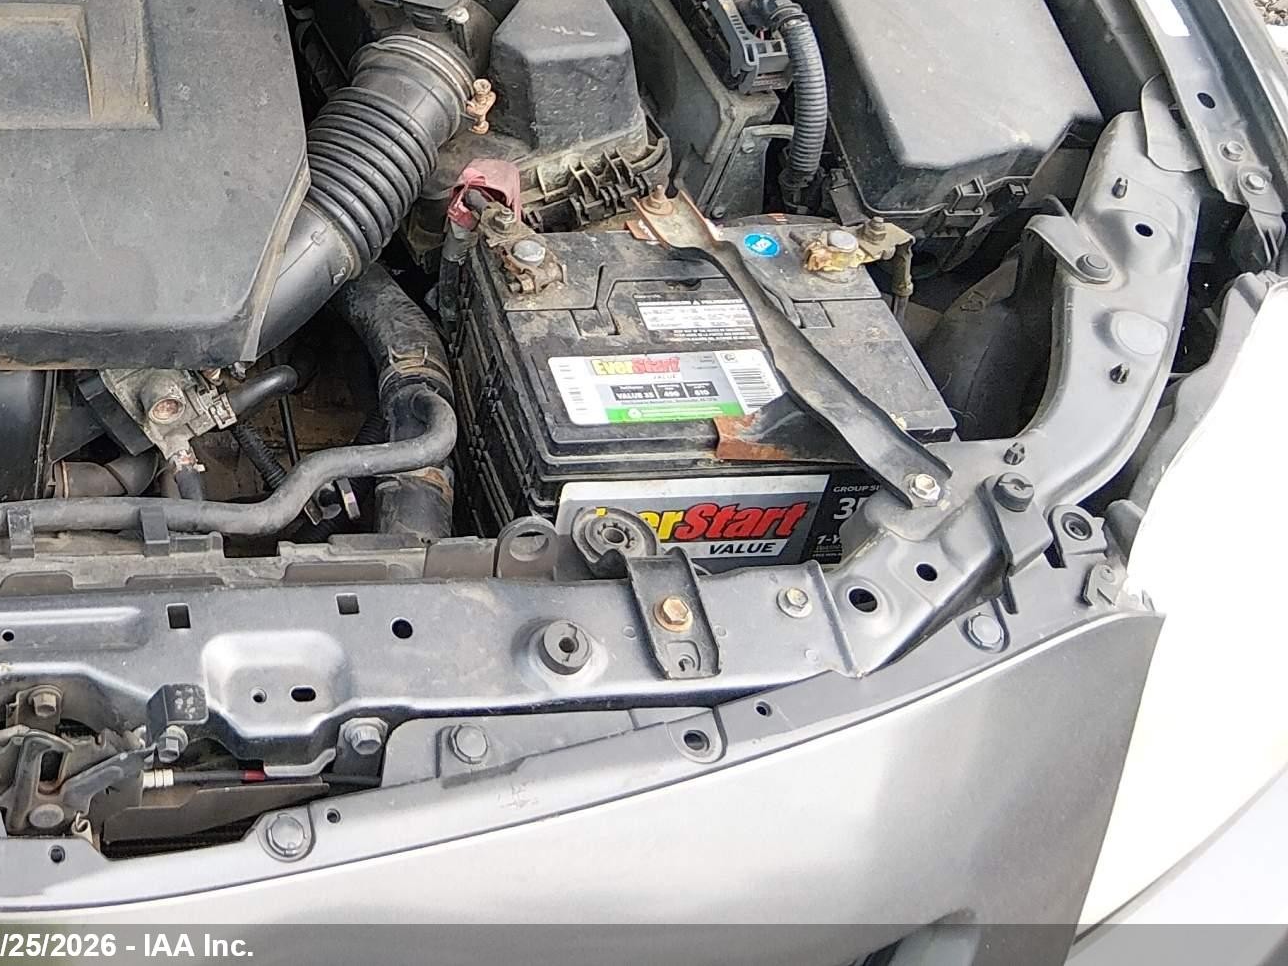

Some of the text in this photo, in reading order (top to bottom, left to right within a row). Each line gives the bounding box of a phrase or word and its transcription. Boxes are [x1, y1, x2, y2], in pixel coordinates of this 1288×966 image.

[591, 357, 681, 375] EverStart
[833, 485, 868, 493] GROUP
[709, 542, 778, 556] VALUE
